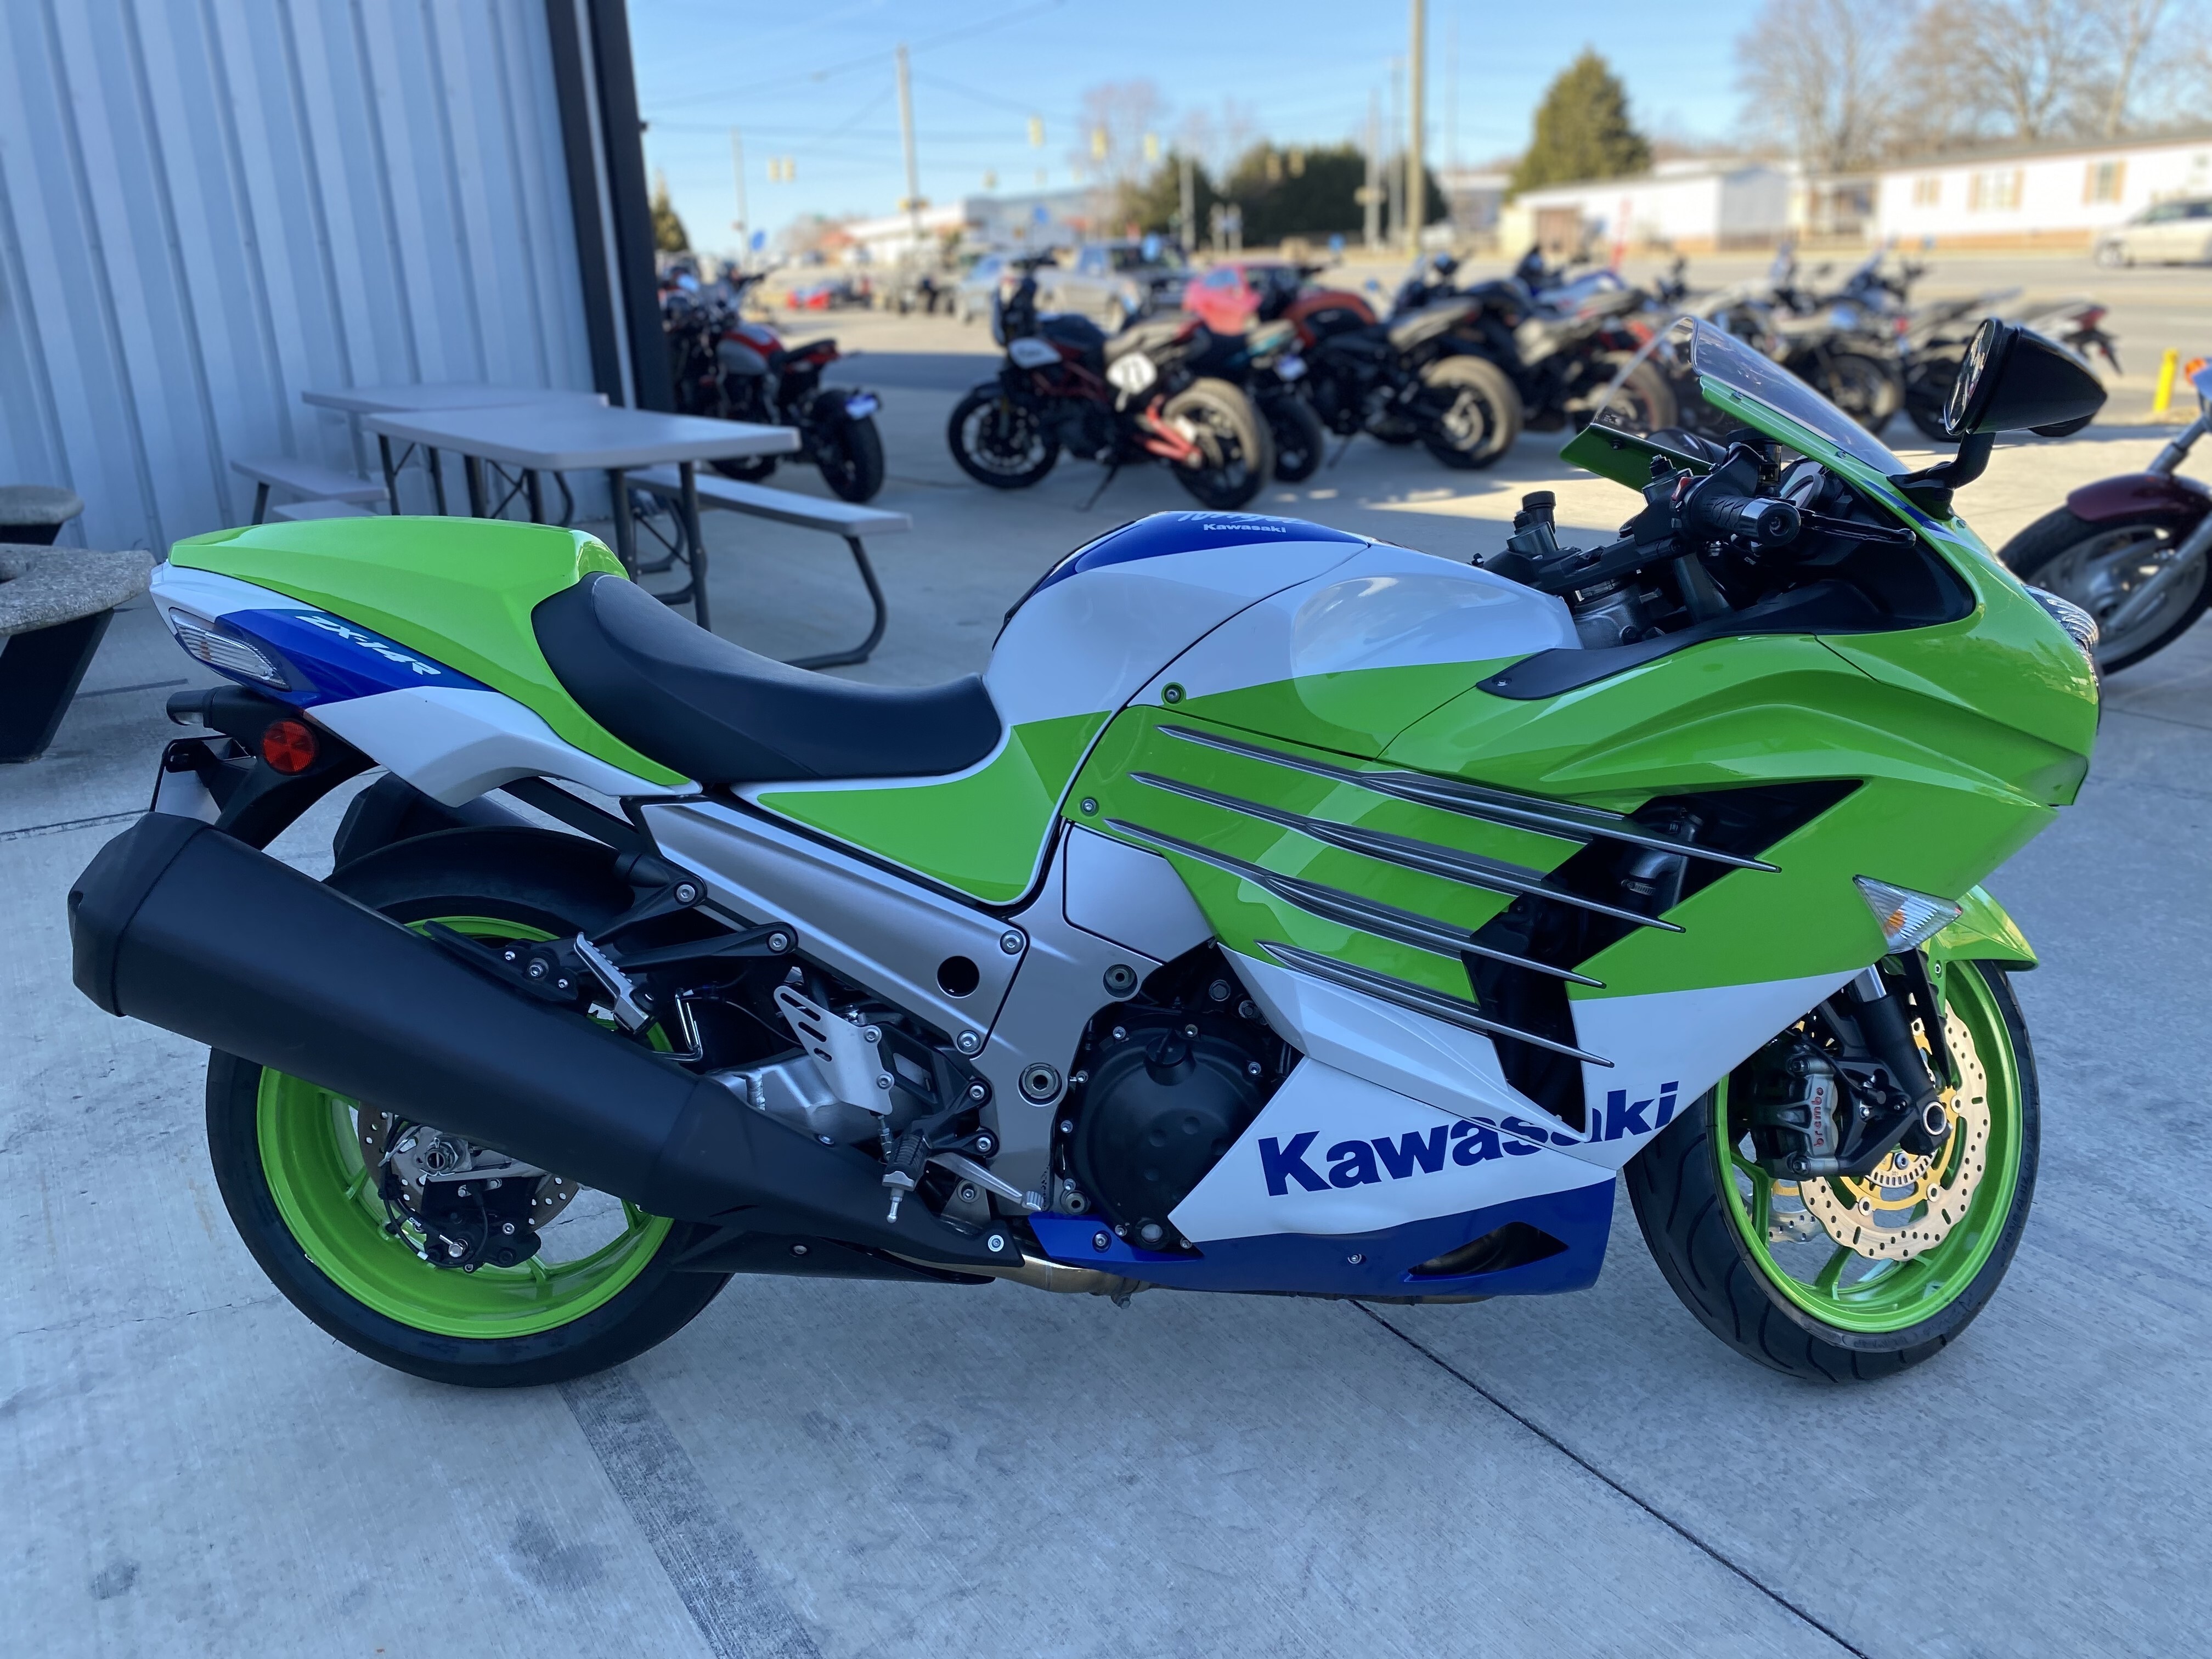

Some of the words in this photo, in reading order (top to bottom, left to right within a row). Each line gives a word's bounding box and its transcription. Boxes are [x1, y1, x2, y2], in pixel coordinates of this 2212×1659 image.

[1203, 523, 1286, 533] Kawasaki
[295, 616, 441, 675] ZX-14R
[1811, 1087, 1825, 1148] brembo
